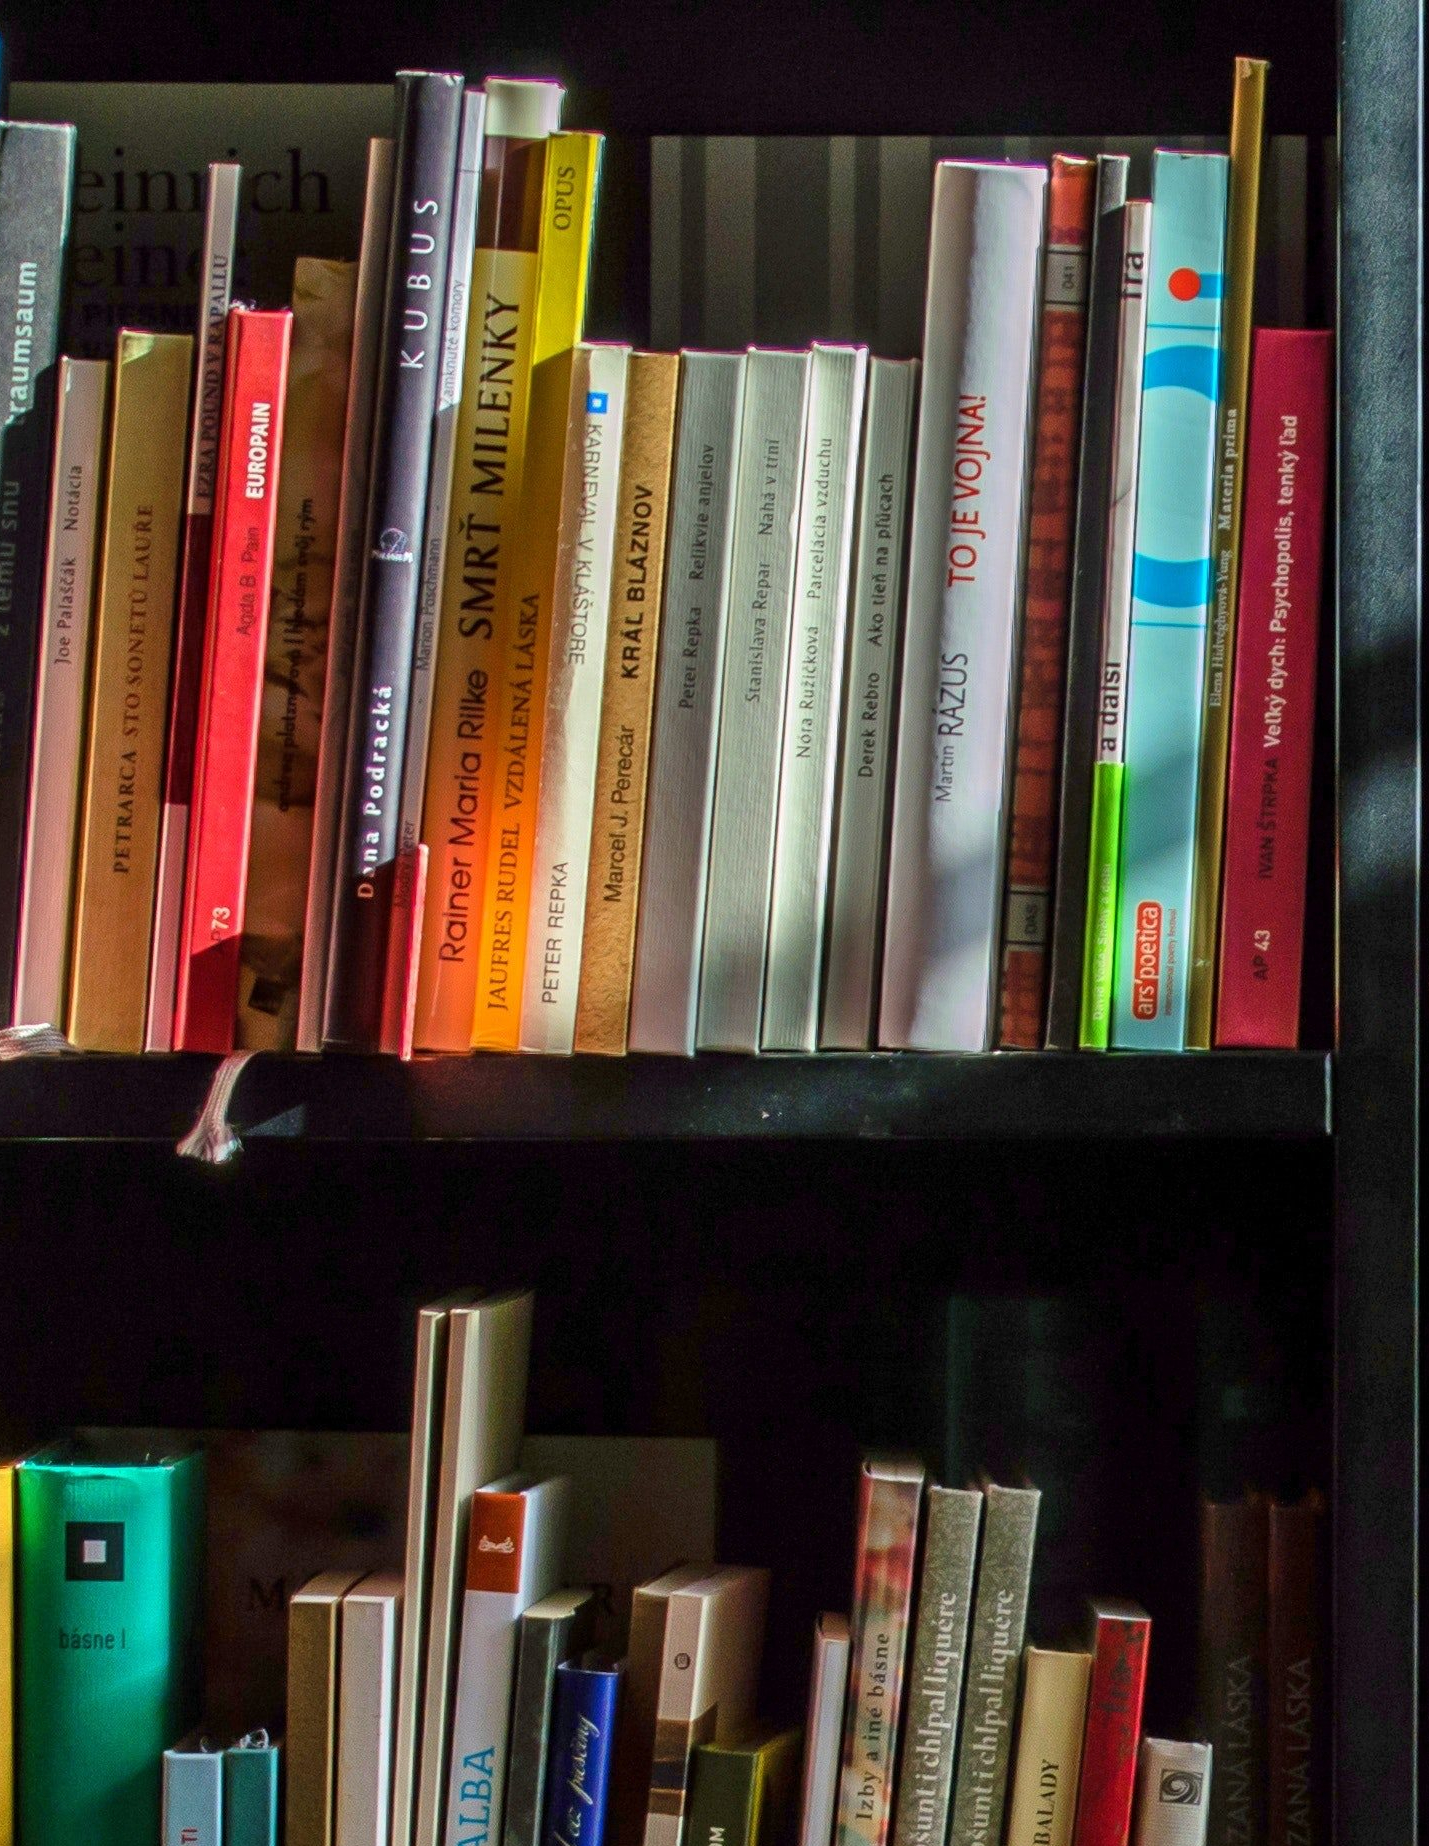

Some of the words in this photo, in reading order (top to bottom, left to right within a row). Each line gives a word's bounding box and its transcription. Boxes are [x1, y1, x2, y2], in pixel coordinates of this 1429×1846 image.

[552, 165, 577, 231] OPUS
[400, 199, 439, 369] KUBUS
[470, 291, 521, 497] MILENKY
[245, 402, 271, 500] EUROPAIN
[580, 423, 604, 526] KARNEVAL
[952, 394, 992, 502] VOJNA!
[950, 509, 987, 542] JE
[454, 513, 501, 642] SMRŤ
[946, 545, 978, 588] TO
[54, 637, 72, 665] Joe
[415, 618, 433, 672] Marion
[745, 617, 768, 704] Stanislava
[868, 612, 885, 647] Ako
[122, 693, 141, 737] STO
[455, 669, 490, 741] Rilke
[679, 666, 698, 710] Peter
[861, 672, 881, 722] Rebro
[931, 652, 969, 737] RÁZUS
[361, 685, 393, 816] Podracká
[858, 729, 877, 778] Derek
[114, 751, 138, 875] PETRARCA
[446, 751, 481, 847] Maria
[497, 822, 521, 903] RUDEL
[547, 860, 569, 929] REPKA
[602, 833, 627, 903] Marcel
[438, 856, 471, 962] Rainer
[1255, 929, 1271, 952] 43
[486, 910, 513, 1012] JAUFRES
[541, 936, 562, 1004] PETER
[865, 1632, 890, 1698] básne
[861, 1707, 883, 1742] iné
[915, 1689, 952, 1769] chlpal
[855, 1771, 882, 1821] Izby
